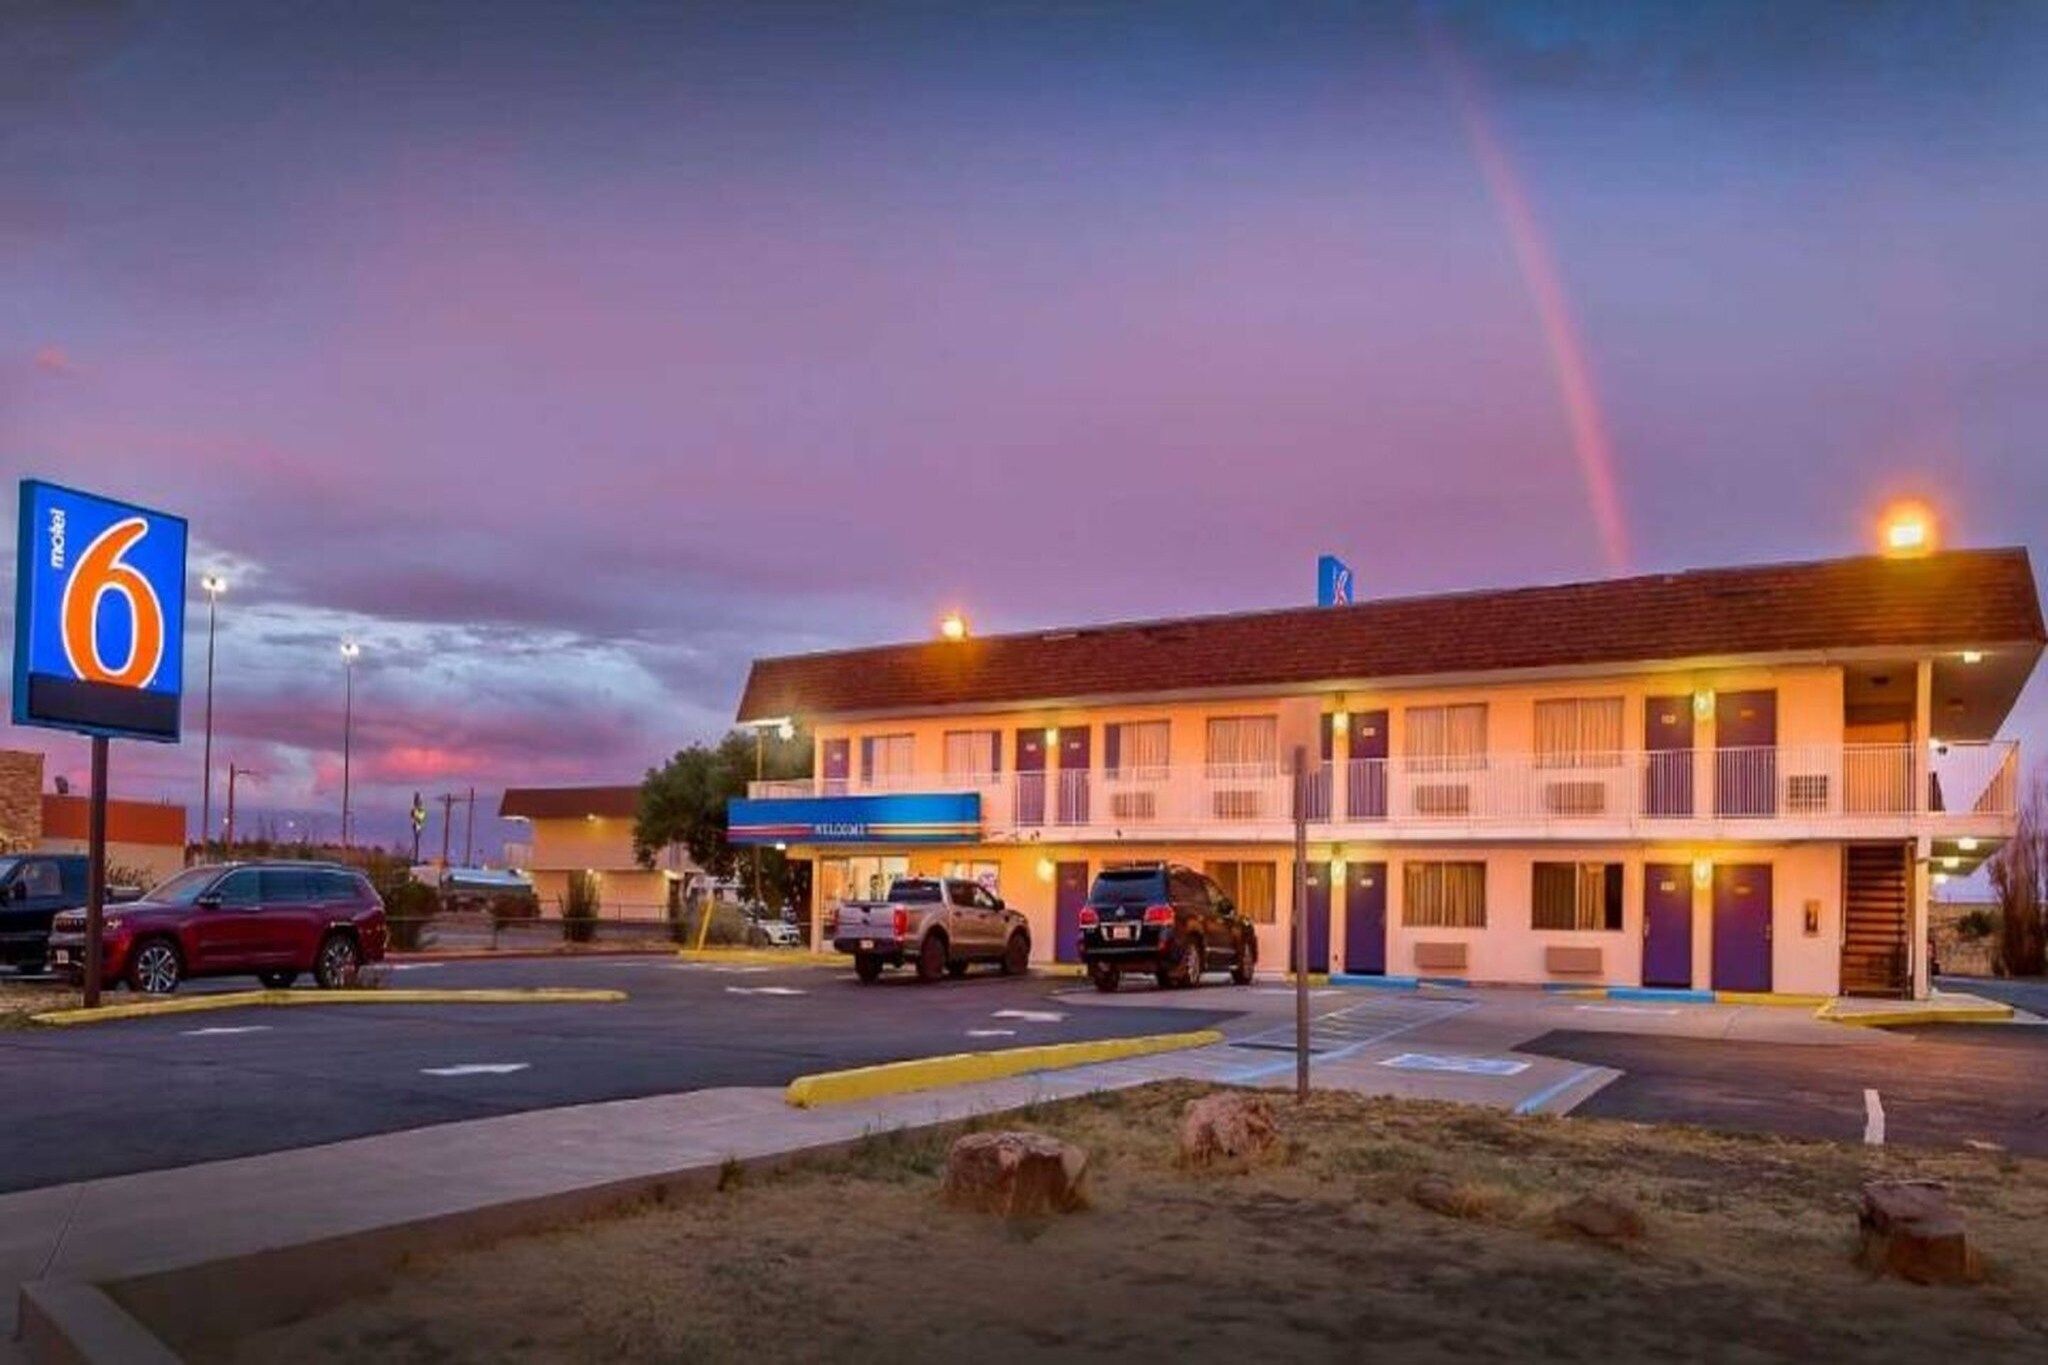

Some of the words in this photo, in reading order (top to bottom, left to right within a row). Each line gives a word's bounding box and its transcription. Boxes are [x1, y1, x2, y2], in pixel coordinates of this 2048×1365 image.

[50, 508, 65, 569] motel
[61, 517, 164, 689] 6
[815, 822, 867, 835] WELCOME
